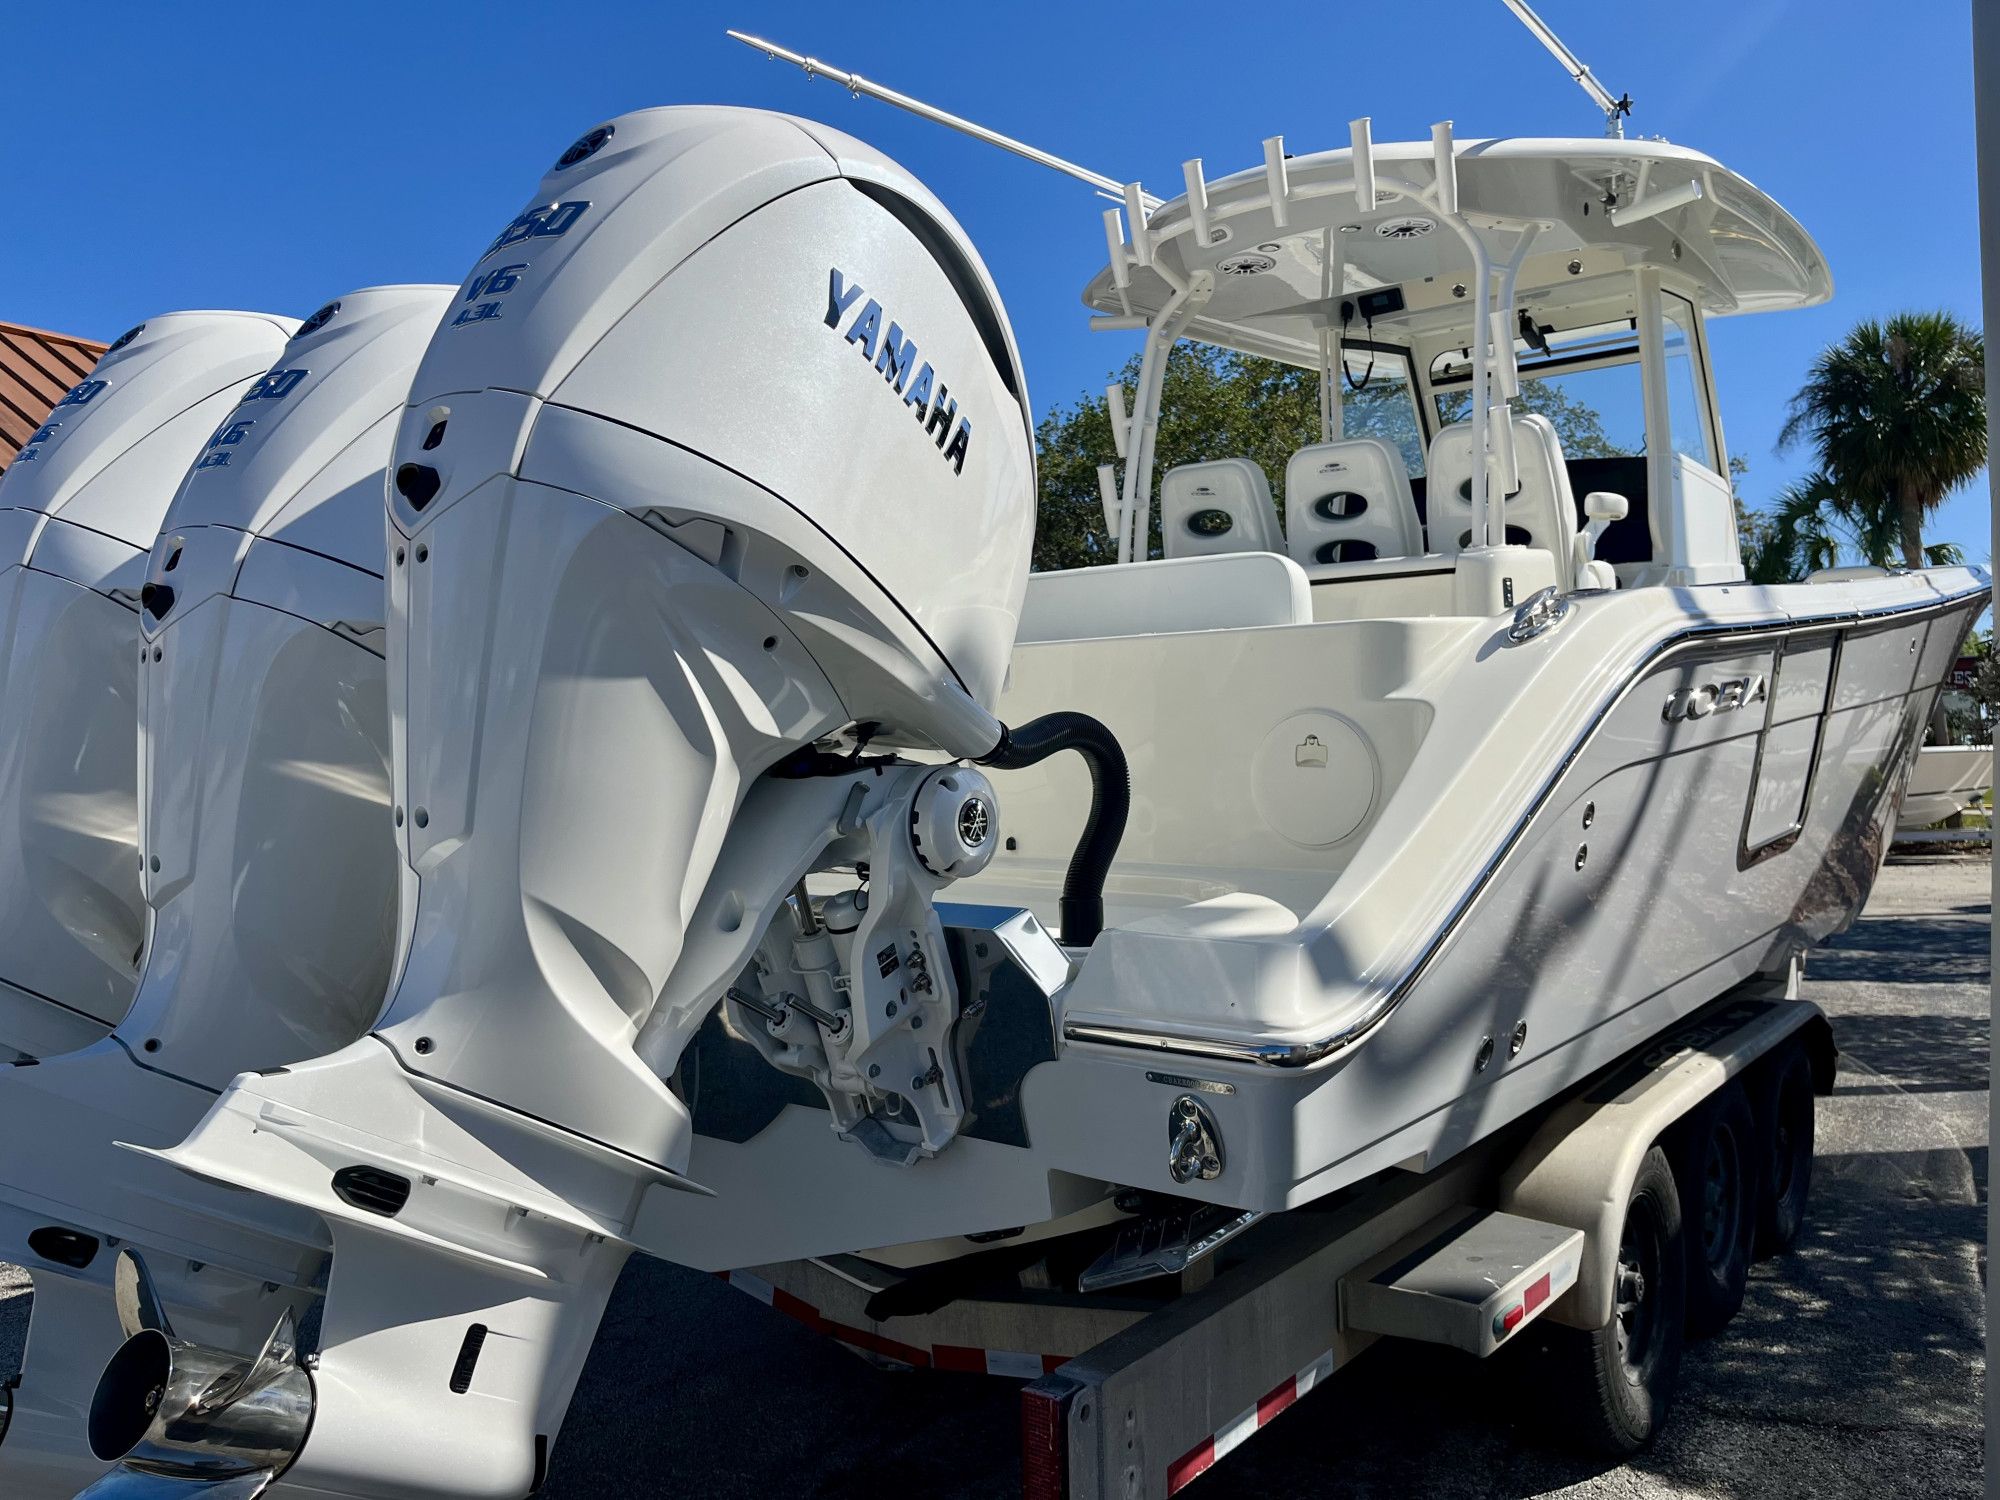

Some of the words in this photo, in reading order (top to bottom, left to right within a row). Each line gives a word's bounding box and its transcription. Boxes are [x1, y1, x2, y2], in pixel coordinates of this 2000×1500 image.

[465, 263, 531, 304] V6
[824, 267, 971, 476] YAMAHA
[1661, 675, 1765, 724] COBIA
